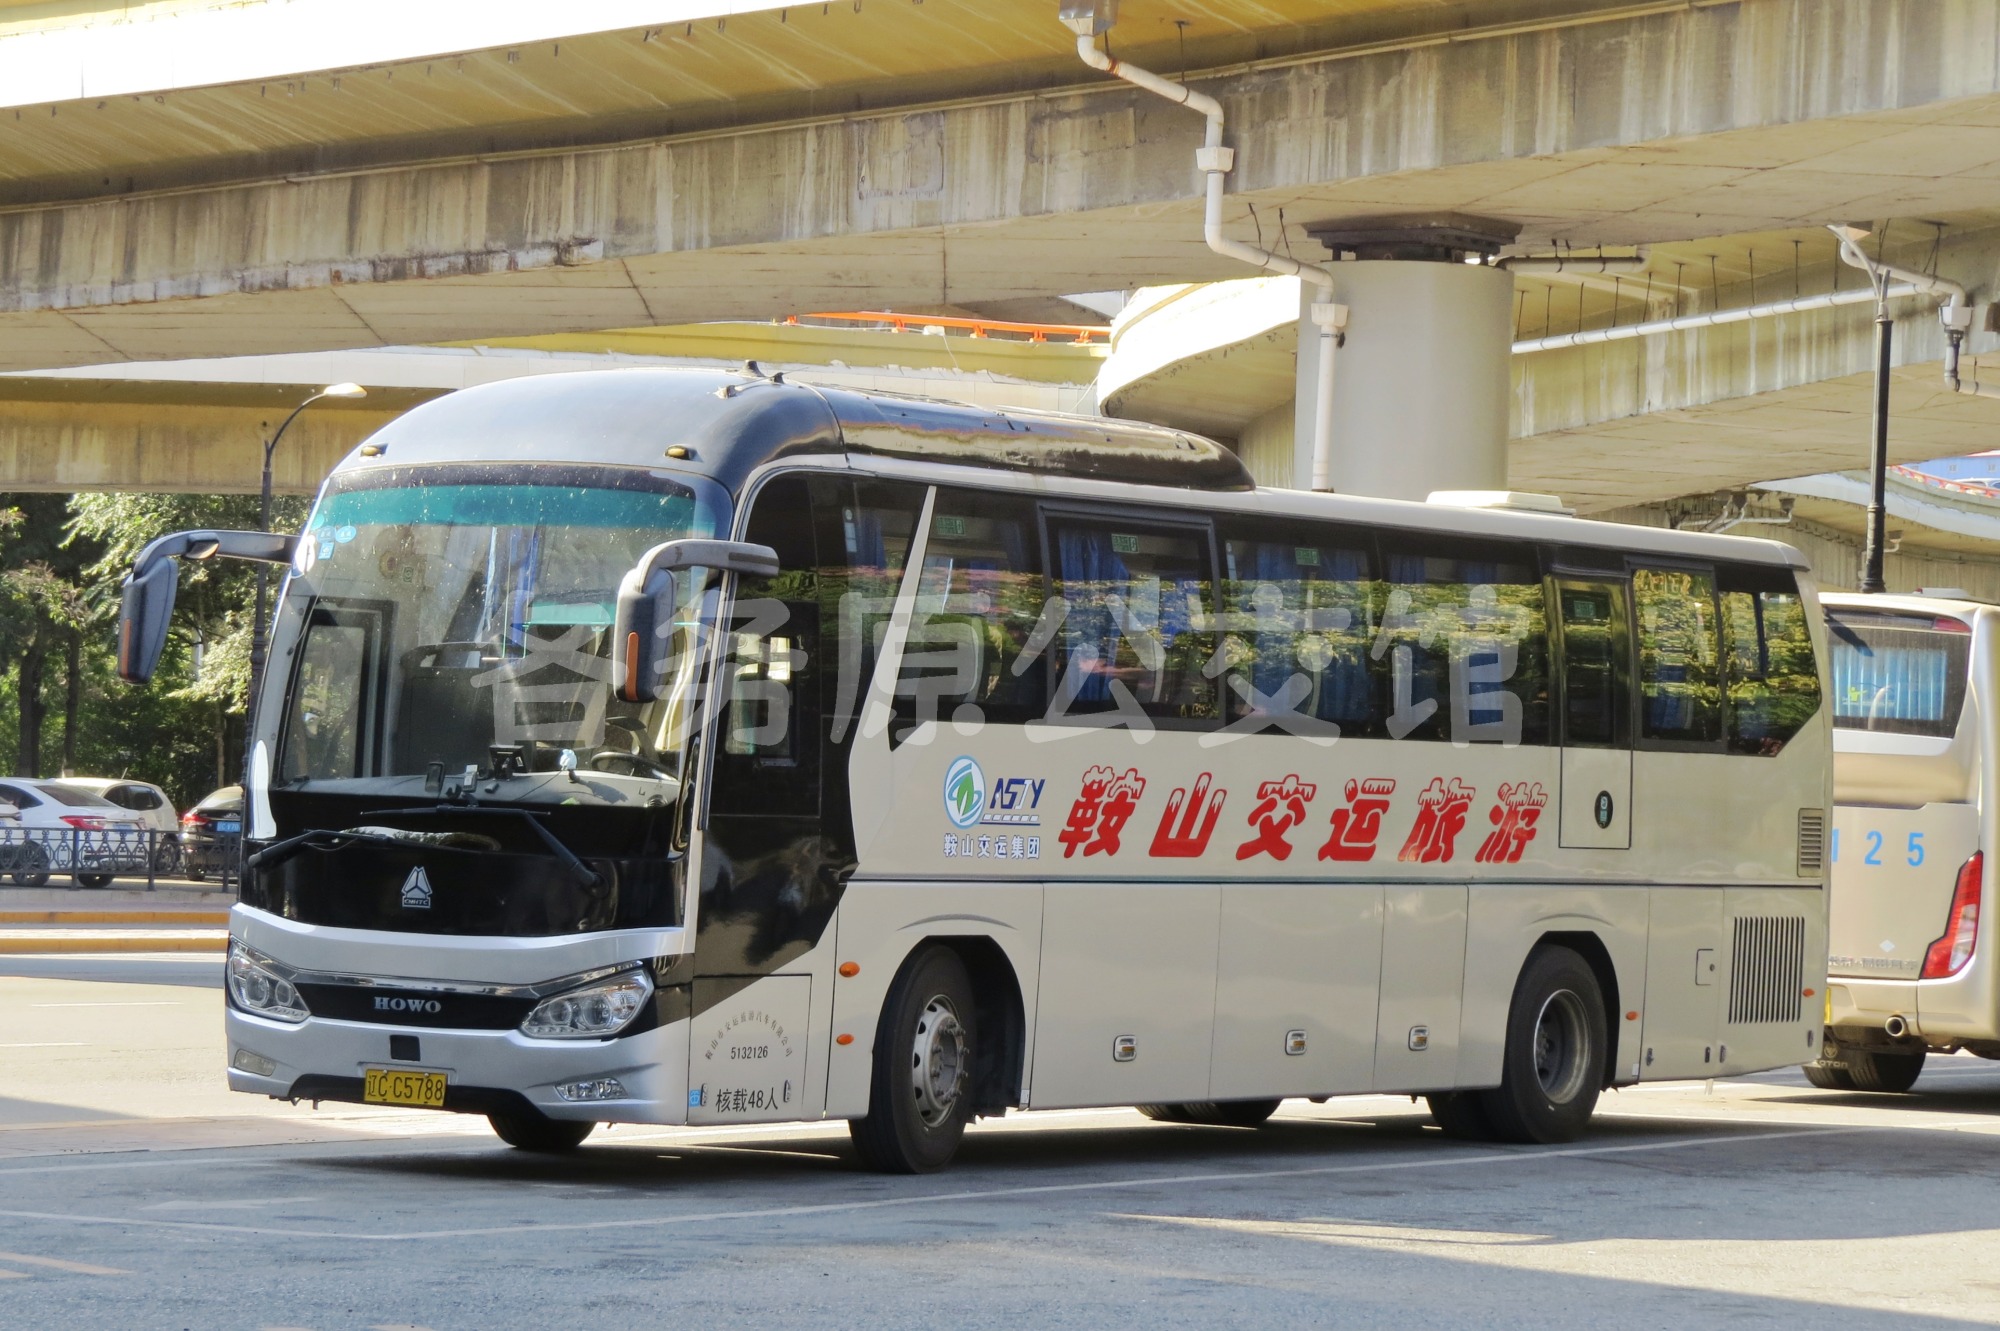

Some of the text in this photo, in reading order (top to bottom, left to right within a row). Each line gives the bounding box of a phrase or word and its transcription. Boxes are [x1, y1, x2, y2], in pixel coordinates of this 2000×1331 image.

[1058, 765, 1549, 863] 鞍山交运旅游
[943, 832, 1041, 860] 鞍山交运集团
[374, 996, 442, 1014] HOWO
[730, 1045, 769, 1059] 5132126
[715, 1087, 778, 1113] 核载48人
